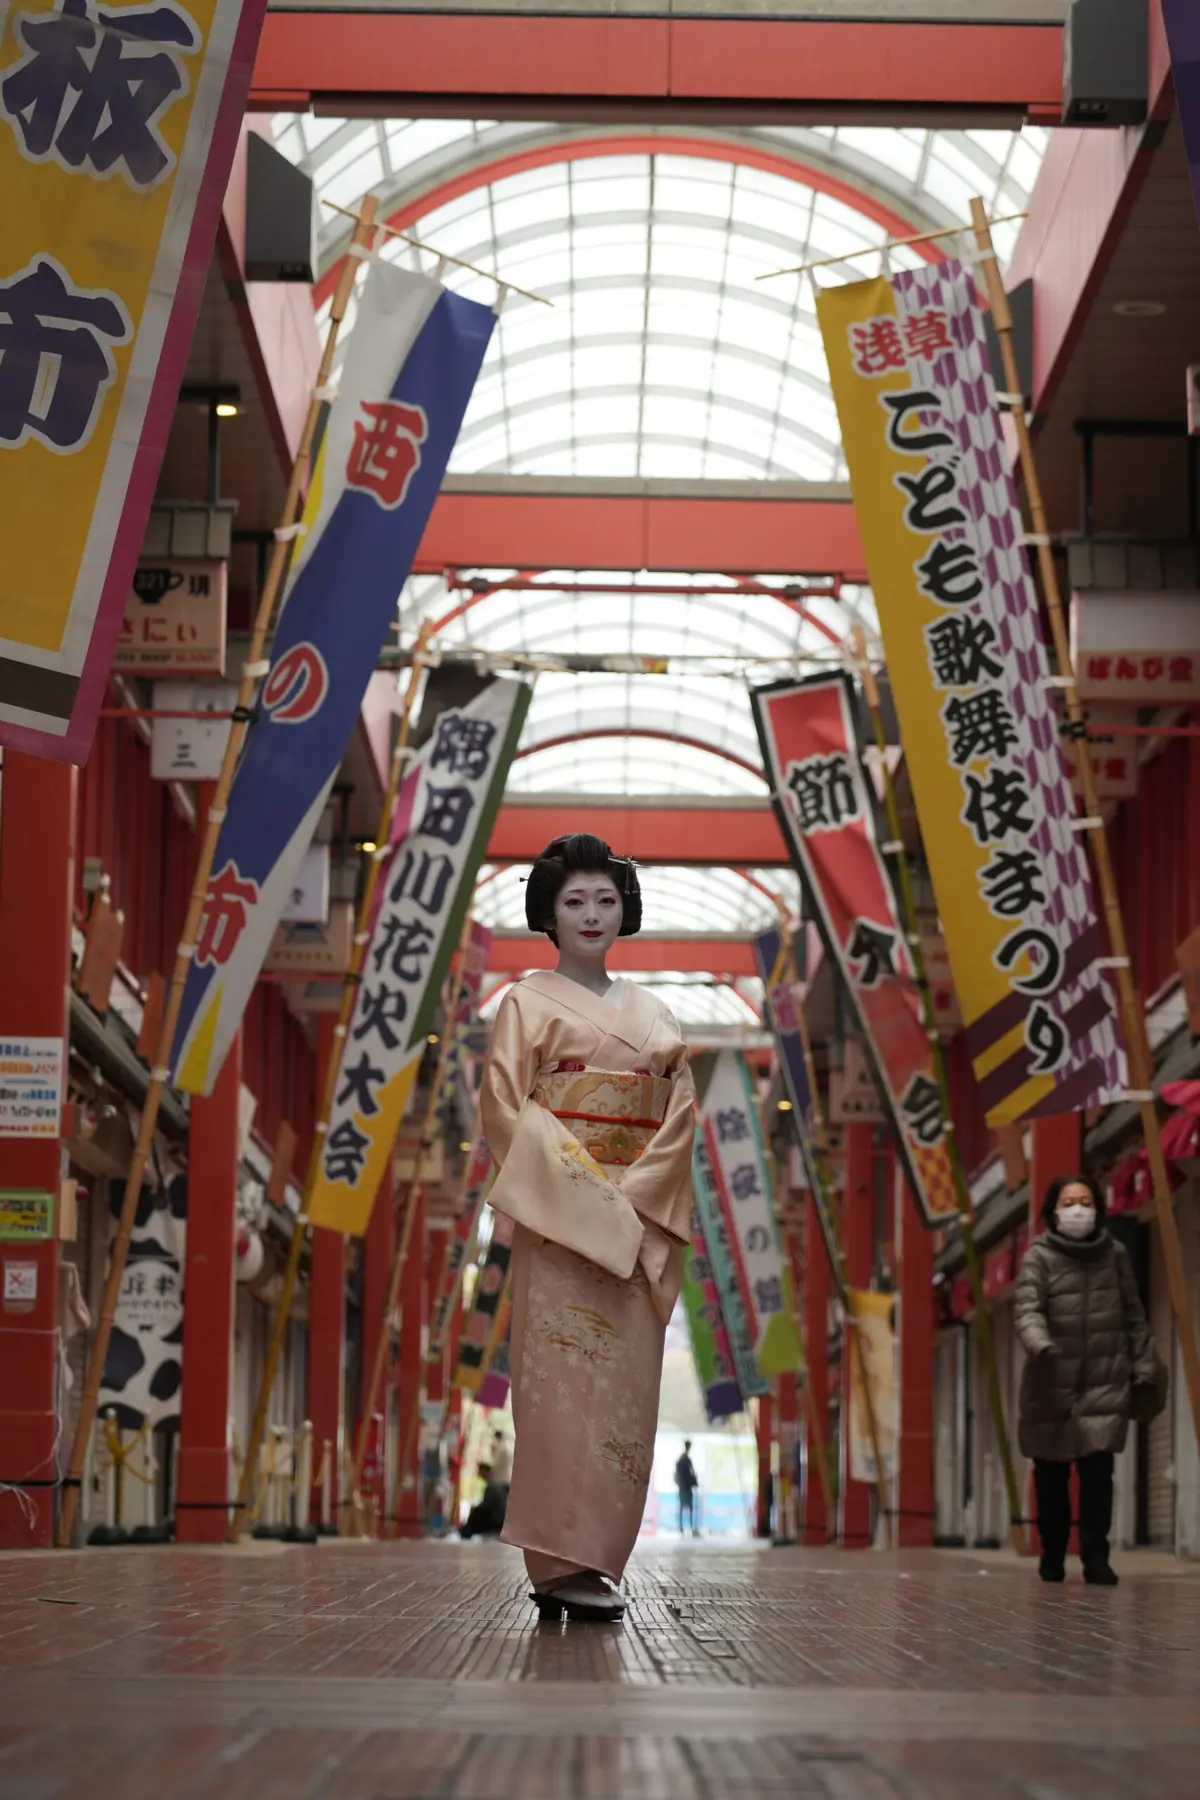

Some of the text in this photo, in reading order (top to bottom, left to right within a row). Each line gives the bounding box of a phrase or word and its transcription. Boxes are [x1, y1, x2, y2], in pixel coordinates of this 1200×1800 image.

[850, 310, 954, 376] 浅草
[885, 392, 1066, 1071] こども歌舞伎まつり
[325, 712, 497, 1186] 隅田川花火大会
[789, 754, 945, 1143] 節分会
